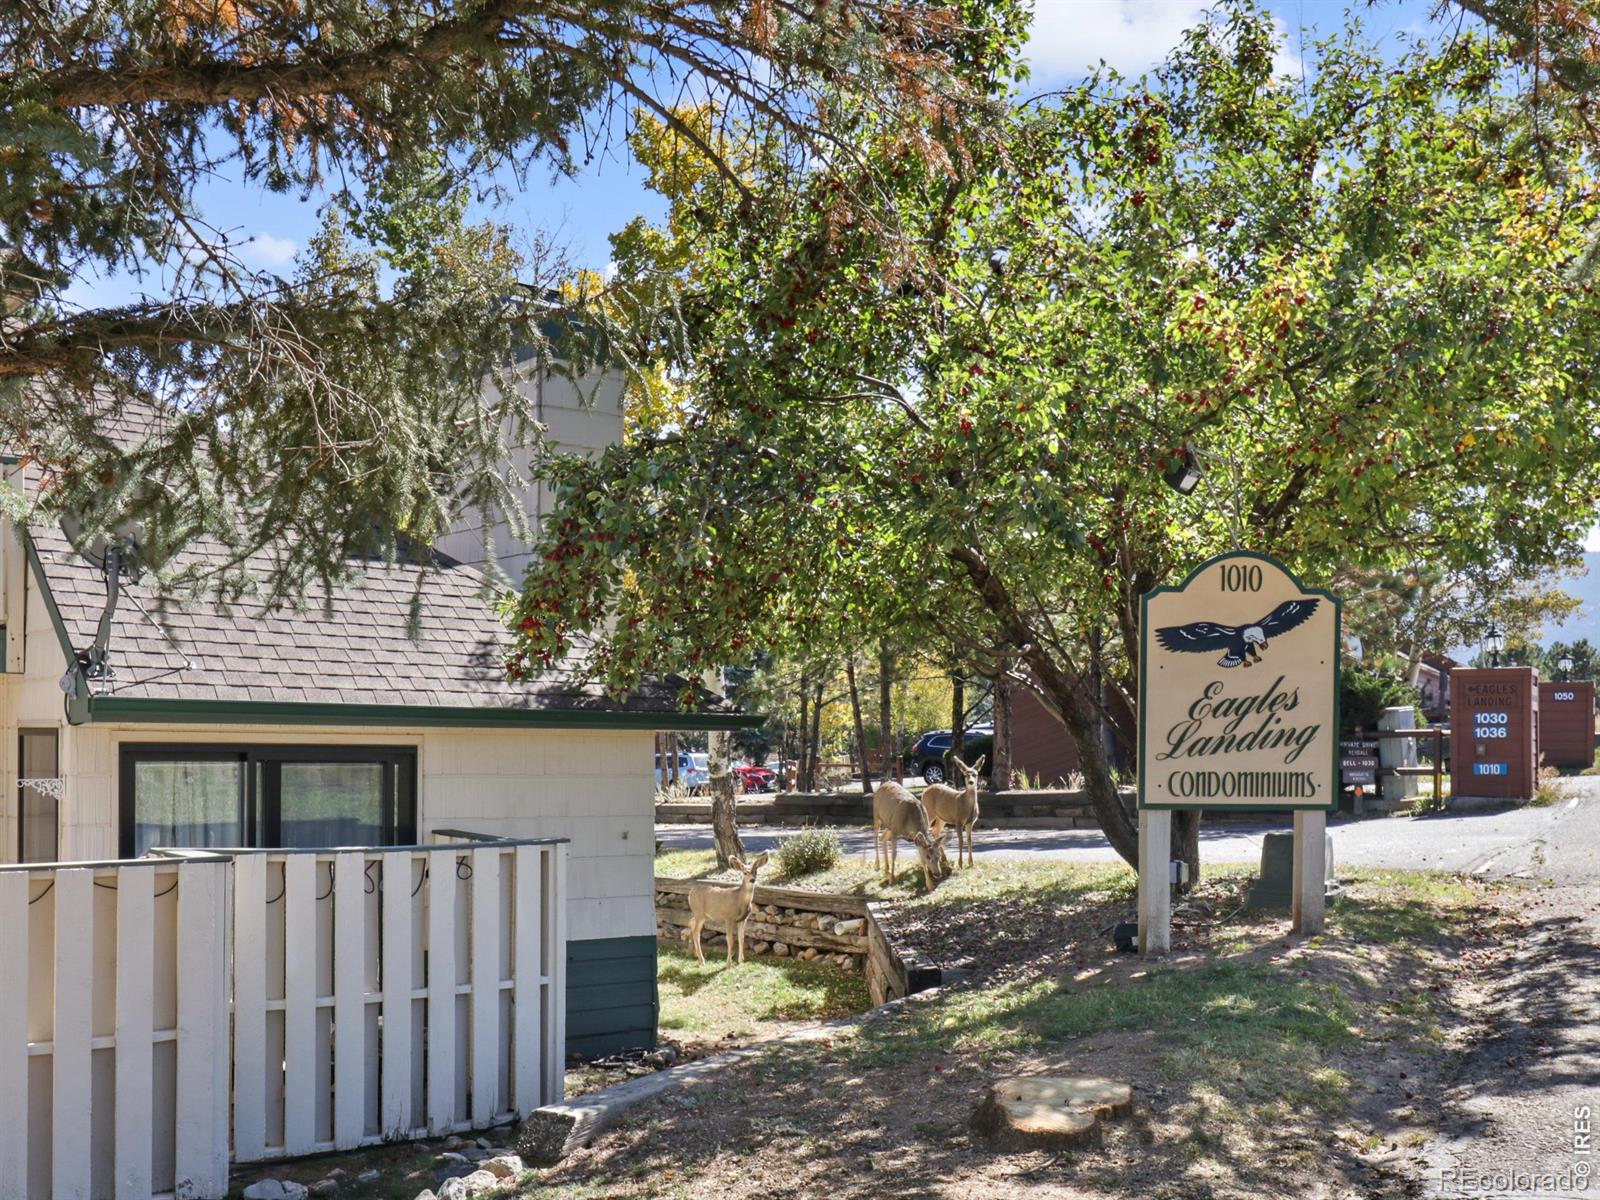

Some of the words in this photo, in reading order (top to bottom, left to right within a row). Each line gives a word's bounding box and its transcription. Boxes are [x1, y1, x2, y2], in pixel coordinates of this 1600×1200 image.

[1220, 564, 1263, 592] 1010
[1476, 684, 1517, 694] EAGLES
[1467, 697, 1512, 706] LANDING
[1554, 692, 1574, 701] 1050
[1188, 675, 1300, 735] Eagles
[1475, 712, 1508, 724] 1030
[1155, 712, 1321, 765] Landing
[1474, 727, 1507, 738] 1036
[1479, 763, 1500, 775] 1010
[1168, 771, 1316, 797] CONDOMINIUMS
